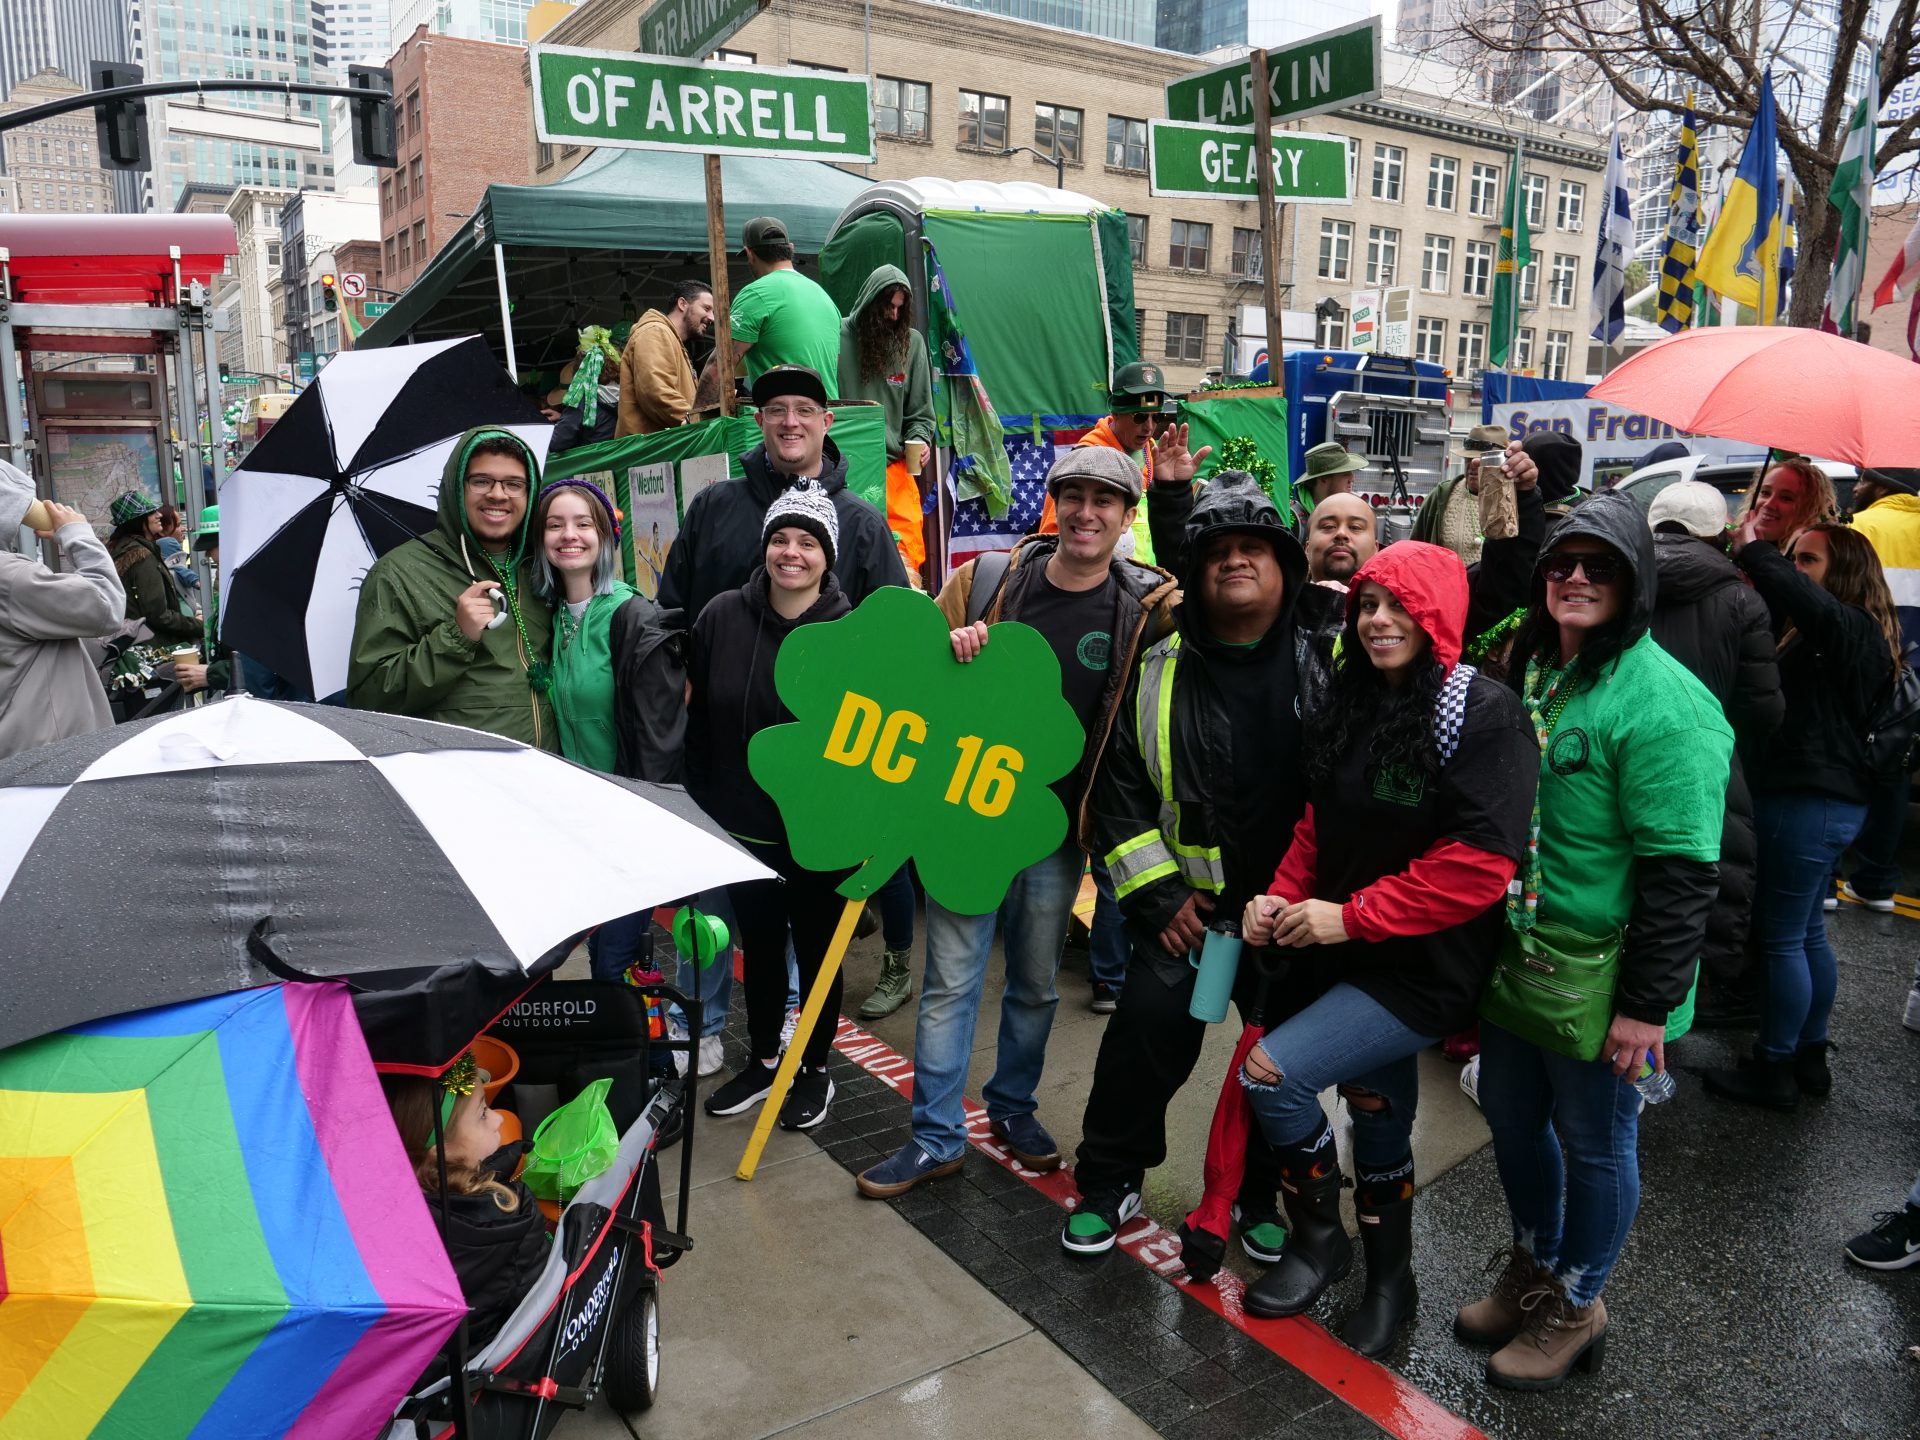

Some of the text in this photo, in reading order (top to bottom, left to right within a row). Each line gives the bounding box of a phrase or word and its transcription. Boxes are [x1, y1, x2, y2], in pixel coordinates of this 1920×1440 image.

[1198, 50, 1331, 124] LARKIN
[1201, 140, 1303, 188] GEARY
[1353, 308, 1370, 321] FOOD
[1386, 324, 1402, 334] THE
[1386, 335, 1407, 346] EAST
[635, 468, 665, 496] Wexford
[823, 690, 1024, 817] DC 16
[503, 1000, 597, 1017] NDERFOLD
[502, 1018, 572, 1027] OUTDOOR
[1358, 1160, 1413, 1182] VANS
